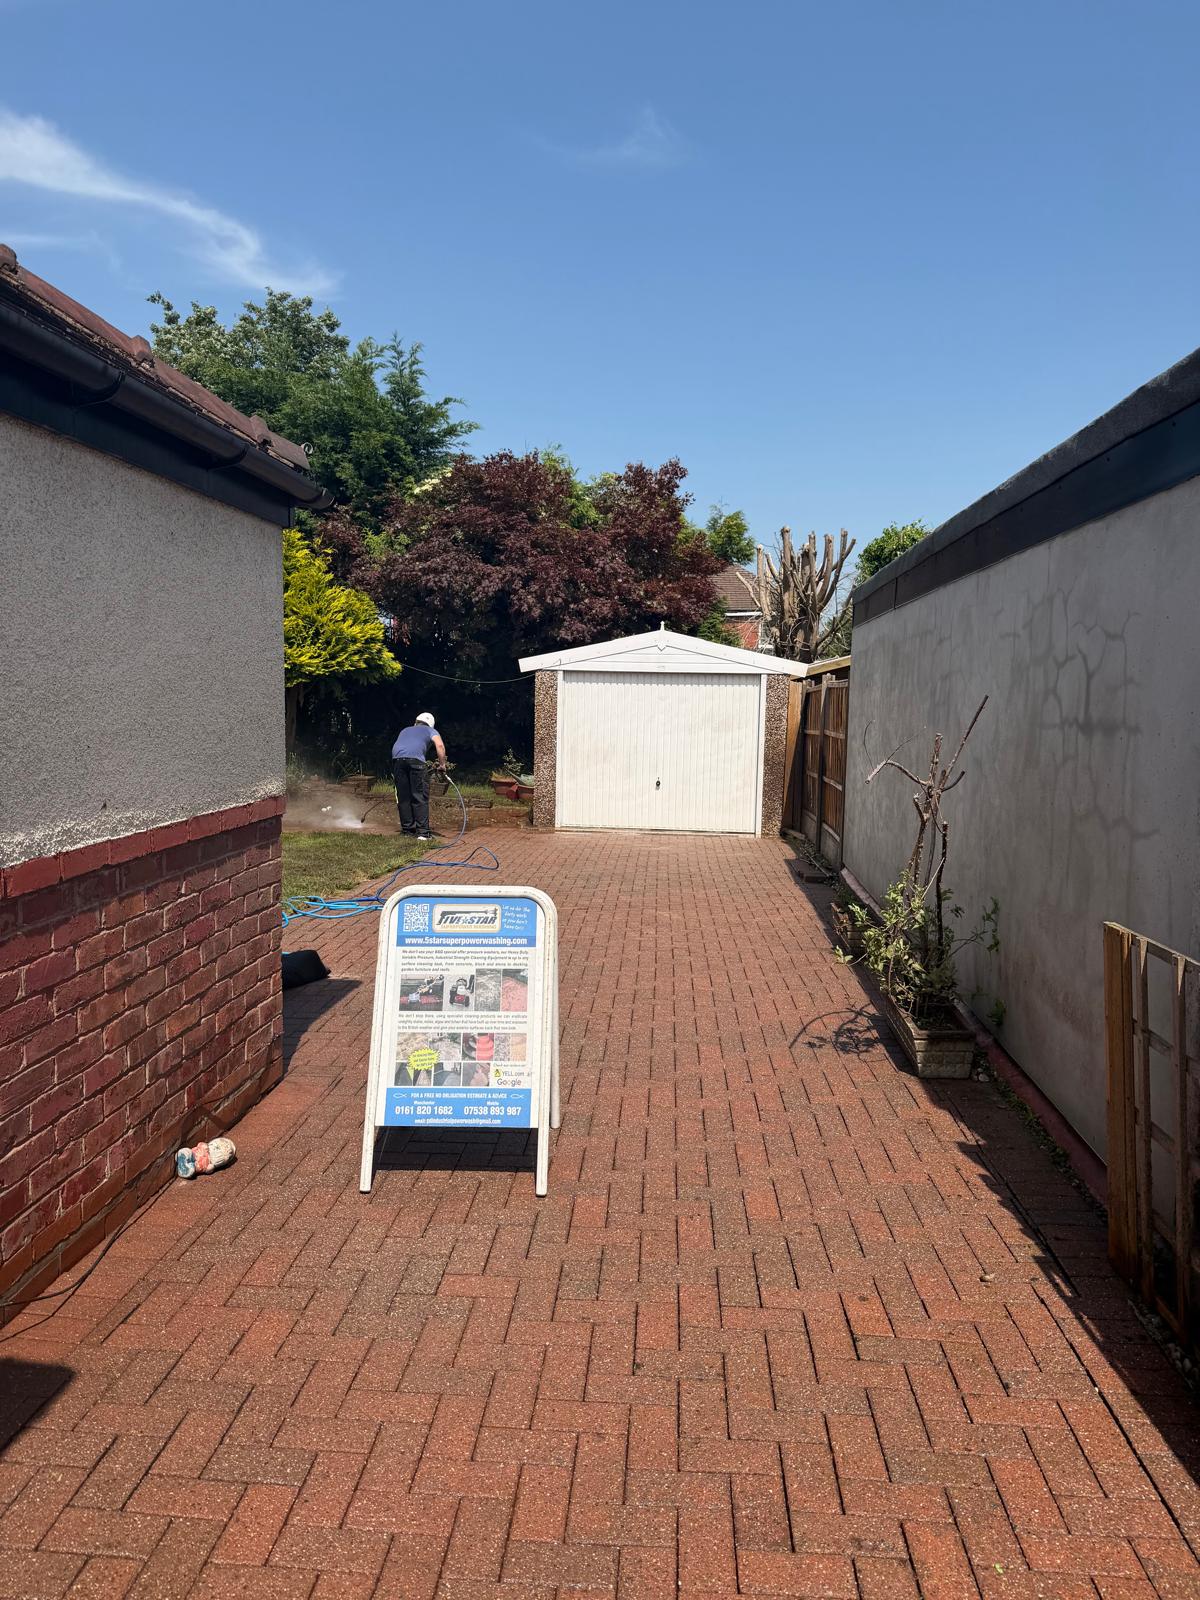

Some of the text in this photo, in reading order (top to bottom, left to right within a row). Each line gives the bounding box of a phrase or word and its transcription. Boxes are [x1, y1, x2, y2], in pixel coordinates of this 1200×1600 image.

[468, 916, 497, 924] STAR
[405, 937, 528, 946] www.5starsuperpowerwashing.com
[497, 1078, 521, 1087] Google
[395, 1106, 453, 1114] 0161 820 1682
[464, 1106, 521, 1115] 07538 893 987
